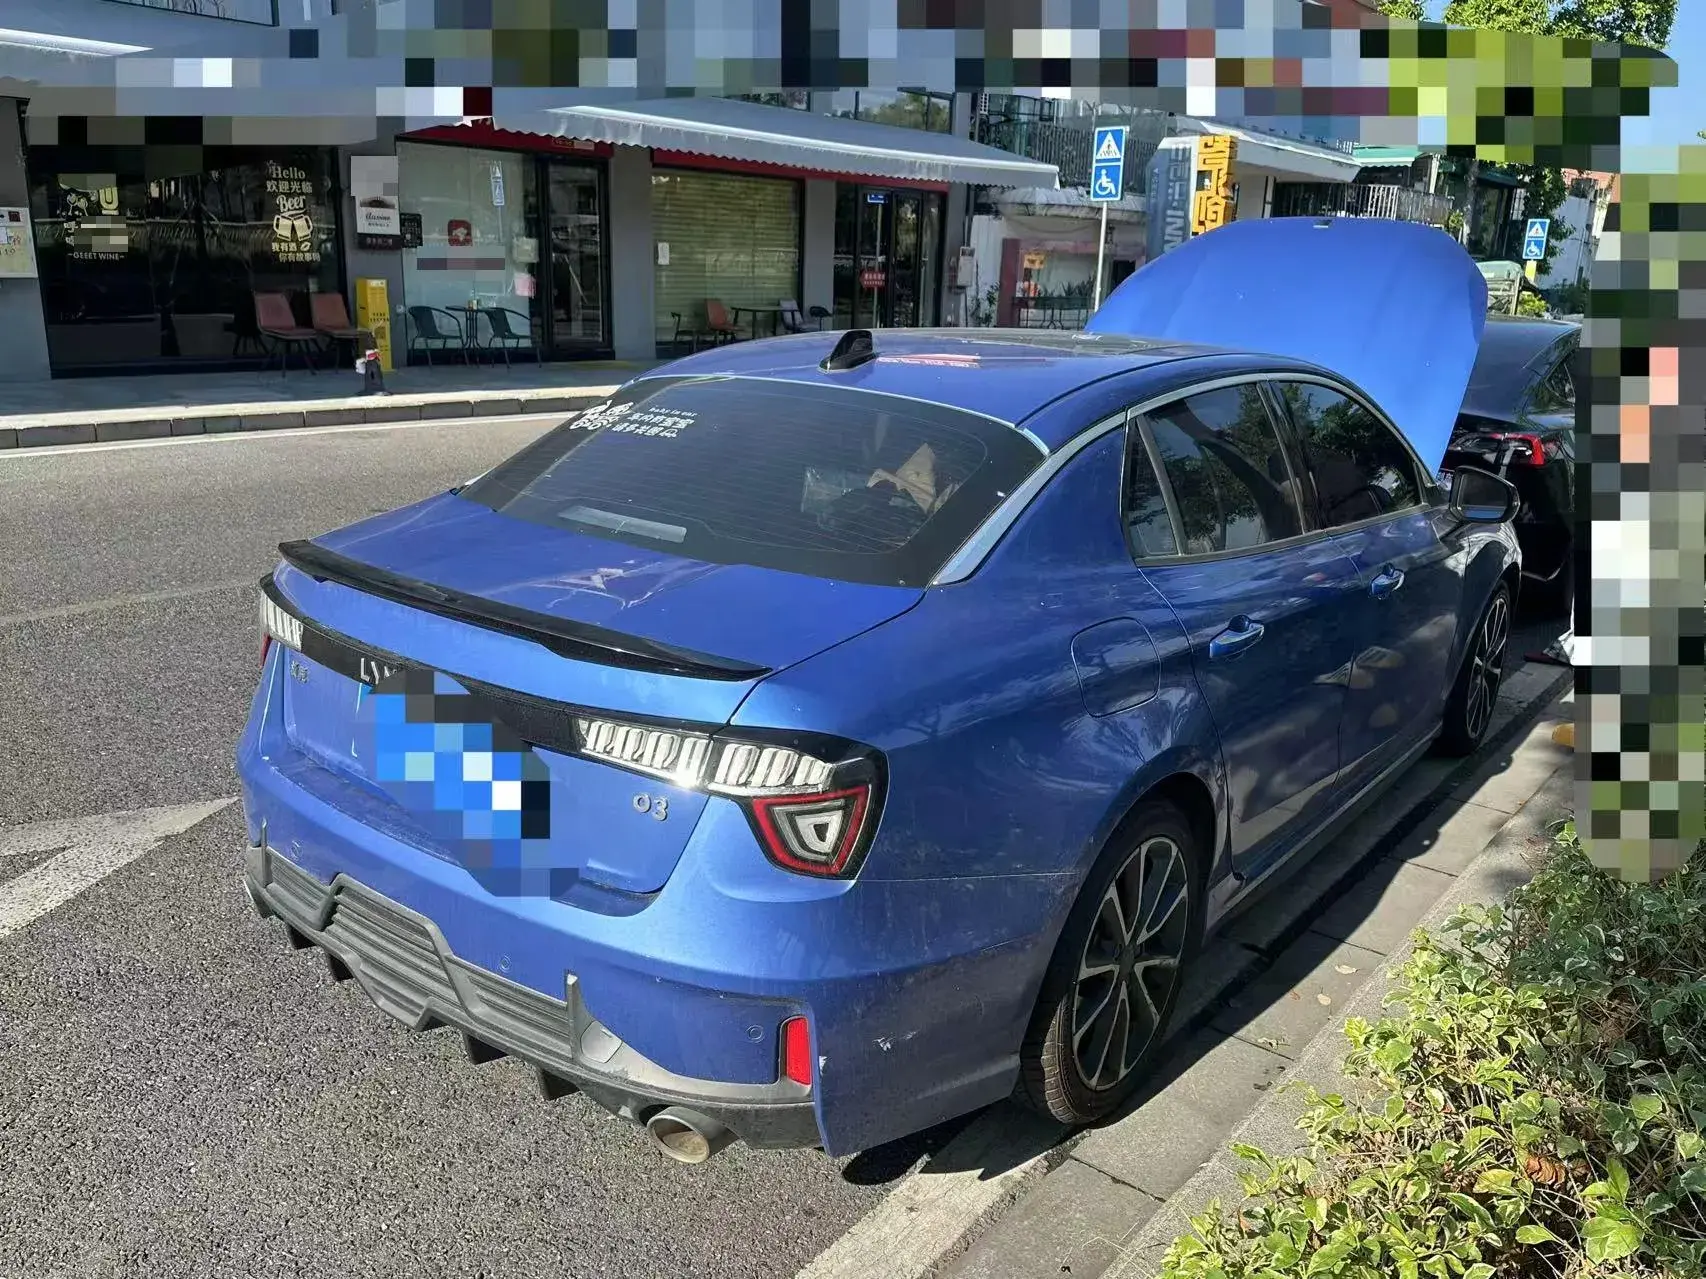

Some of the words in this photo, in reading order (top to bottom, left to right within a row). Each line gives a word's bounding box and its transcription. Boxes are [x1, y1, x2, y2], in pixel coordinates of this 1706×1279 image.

[272, 165, 306, 179] Hello
[266, 180, 313, 194] 欢迎光临
[276, 194, 306, 213] Beer
[271, 242, 298, 252] 我有酒
[98, 252, 120, 261] WINE
[632, 793, 669, 822] 03
